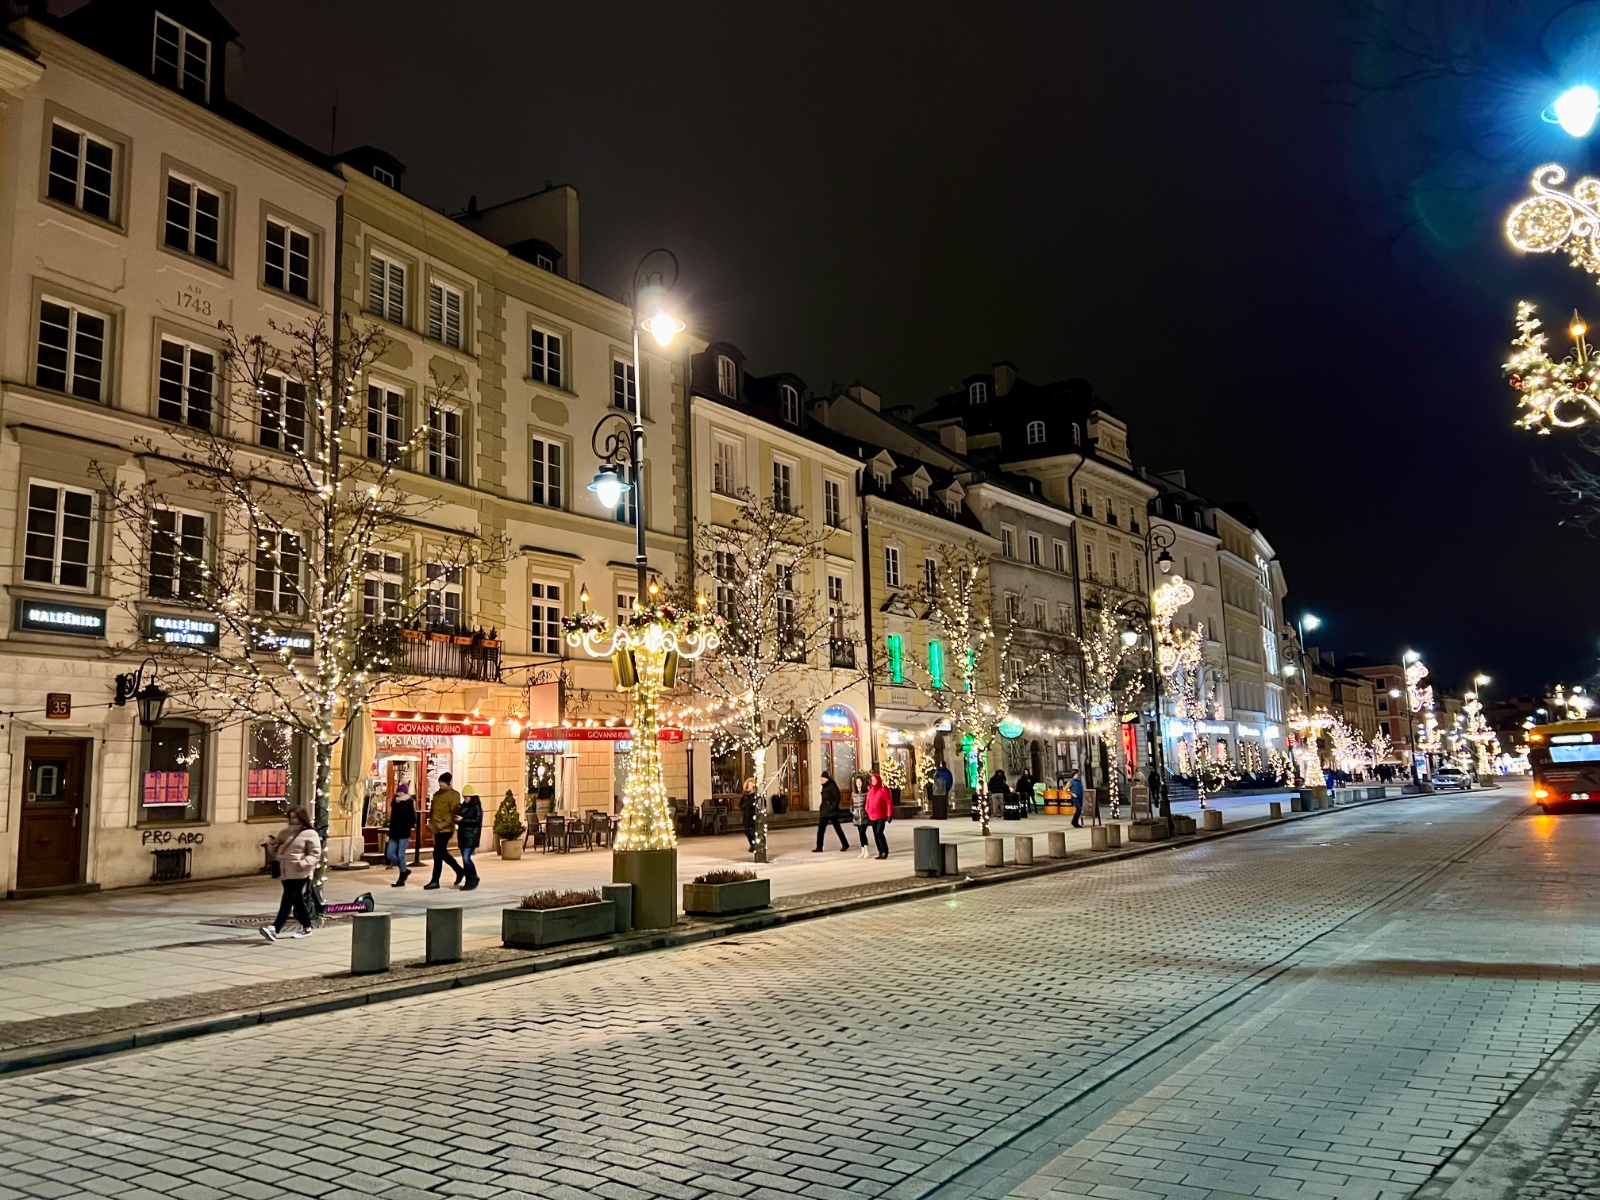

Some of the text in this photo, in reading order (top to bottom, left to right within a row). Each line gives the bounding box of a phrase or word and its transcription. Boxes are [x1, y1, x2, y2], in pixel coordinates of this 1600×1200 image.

[177, 291, 212, 317] 1743
[52, 701, 67, 714] 35
[397, 723, 434, 734] GIOVANNI
[435, 725, 461, 735] RUBINO
[587, 731, 617, 739] GIOVANNI
[384, 734, 441, 746] RESTAURANT
[142, 830, 204, 846] PRO ABO
